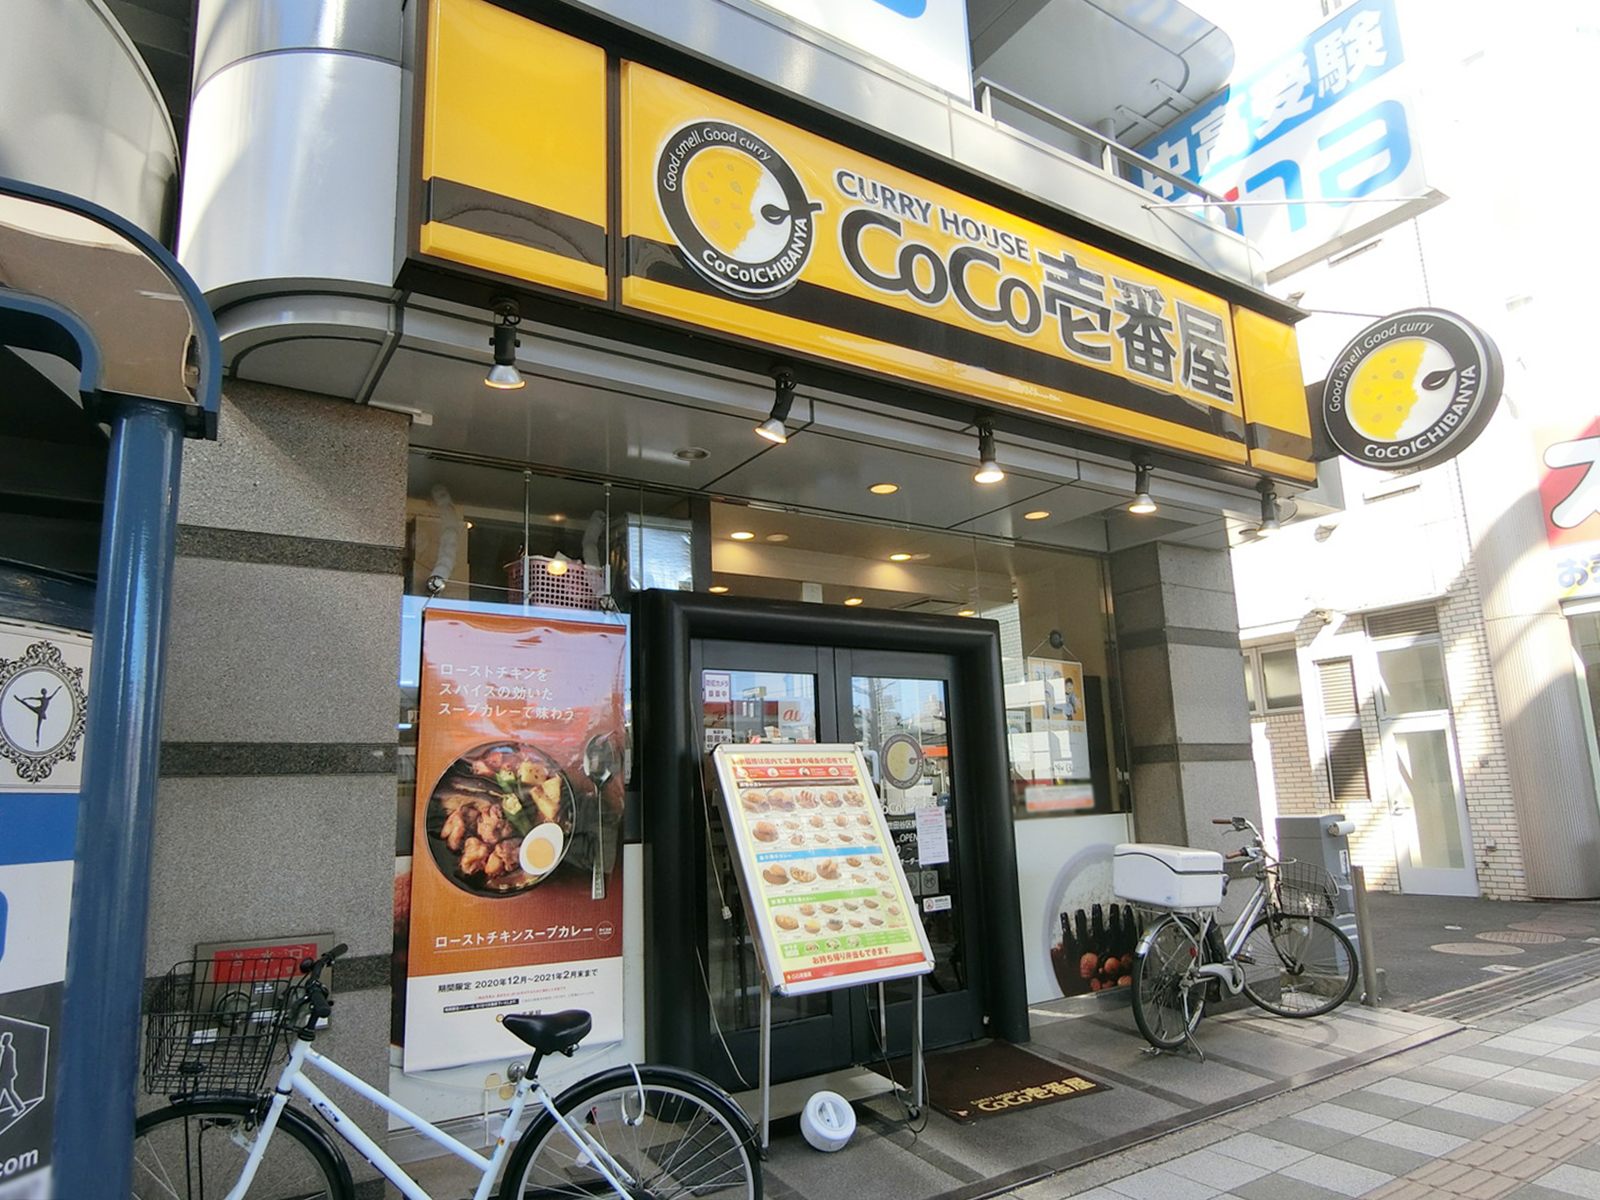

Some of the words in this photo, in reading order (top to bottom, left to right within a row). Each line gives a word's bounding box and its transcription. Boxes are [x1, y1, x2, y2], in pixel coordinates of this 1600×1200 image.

[663, 153, 681, 192] Good
[675, 130, 704, 158] smell.
[703, 128, 737, 143] Good
[739, 137, 771, 161] curry
[834, 168, 933, 222] CURRY
[938, 204, 1031, 262] HOUSE
[702, 217, 807, 283] CoCoICHIBANYA
[839, 206, 1236, 404] CoCo壱番屋
[1329, 379, 1343, 412] Good
[1339, 344, 1365, 378] smell.
[1364, 323, 1398, 349] Good
[1400, 321, 1434, 334] curry
[1364, 364, 1476, 459] CoCoICHIBANYA
[1557, 552, 1600, 588] お
[441, 664, 549, 682] ローストチキンを
[435, 925, 593, 948] ローストチキンスープカレー
